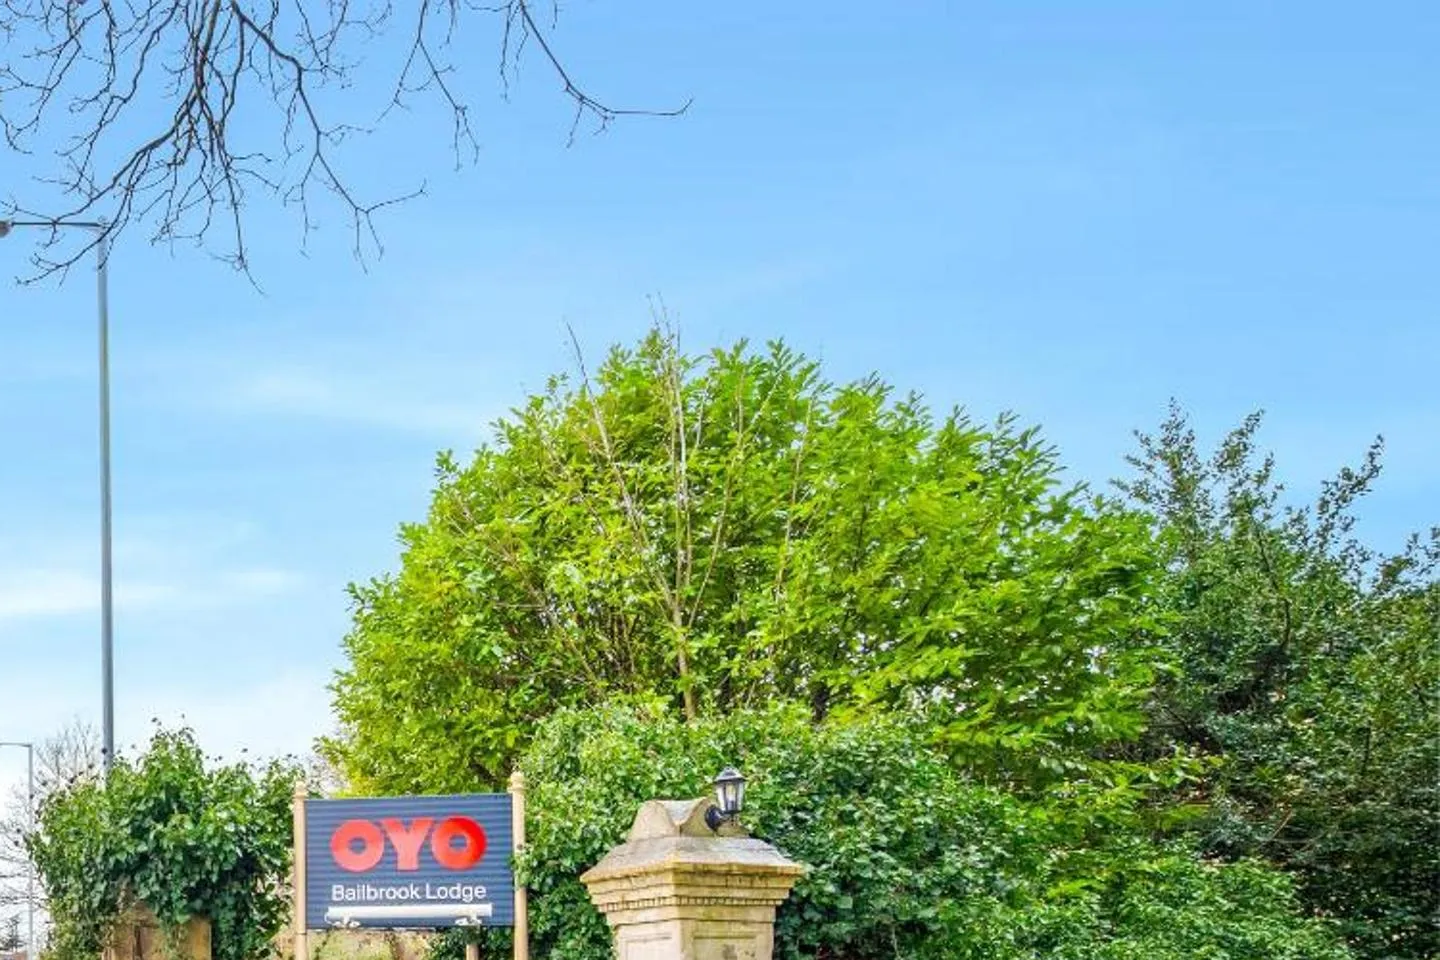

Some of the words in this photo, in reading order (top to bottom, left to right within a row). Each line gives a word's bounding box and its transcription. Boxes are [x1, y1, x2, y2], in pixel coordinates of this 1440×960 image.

[329, 814, 488, 872] OYO
[331, 884, 421, 902] Bailbrook
[425, 883, 487, 903] Lodge
